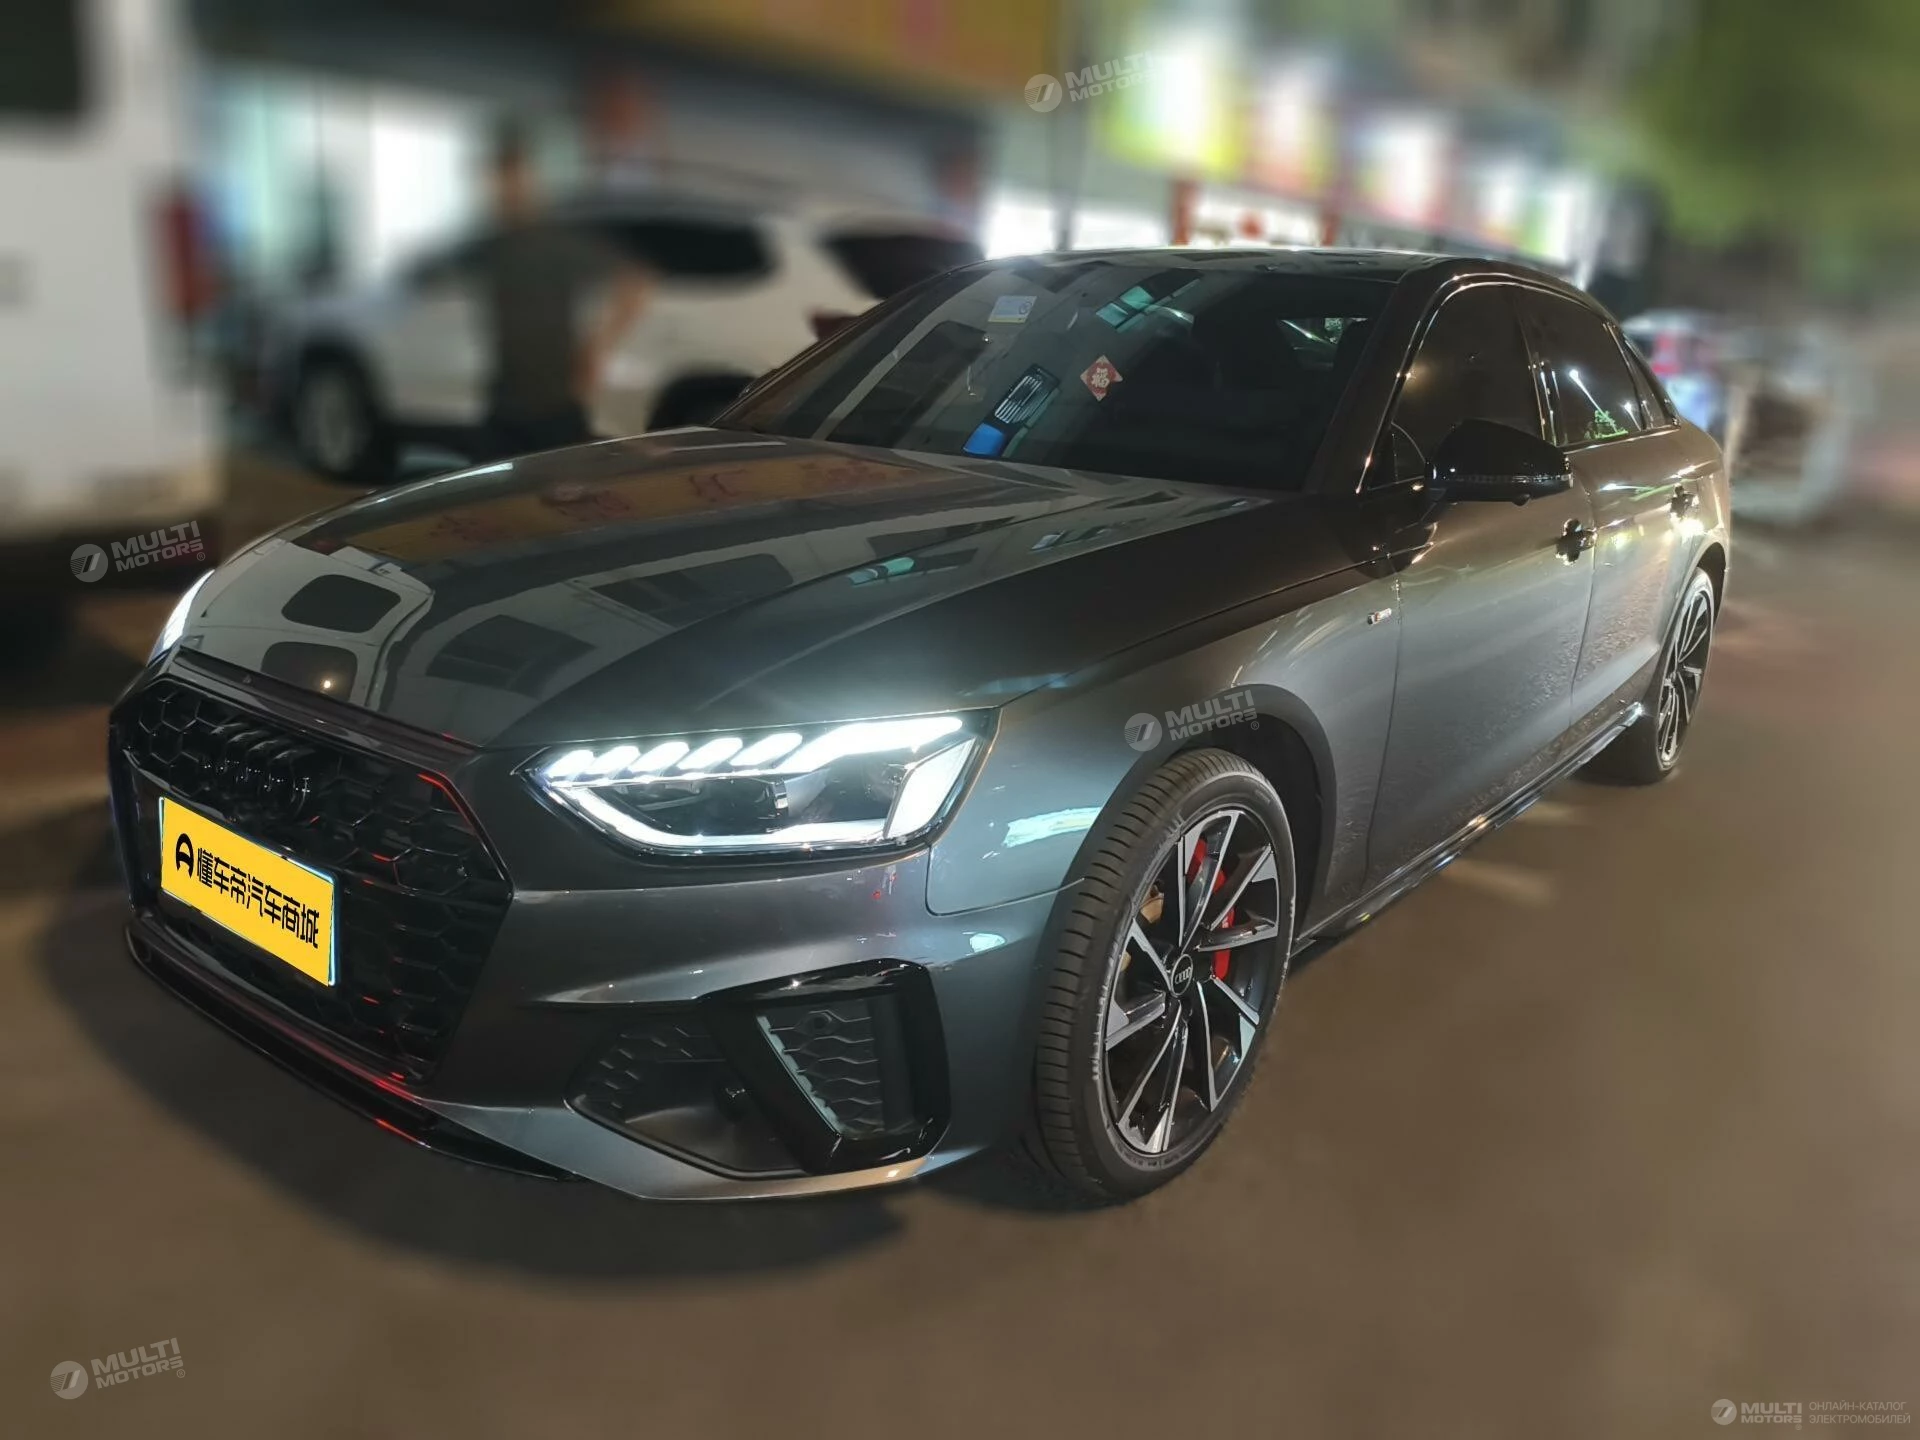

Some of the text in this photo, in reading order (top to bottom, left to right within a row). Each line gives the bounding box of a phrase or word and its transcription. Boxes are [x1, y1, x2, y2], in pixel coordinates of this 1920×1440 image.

[197, 848, 319, 949] 懂车帝汽车商城
